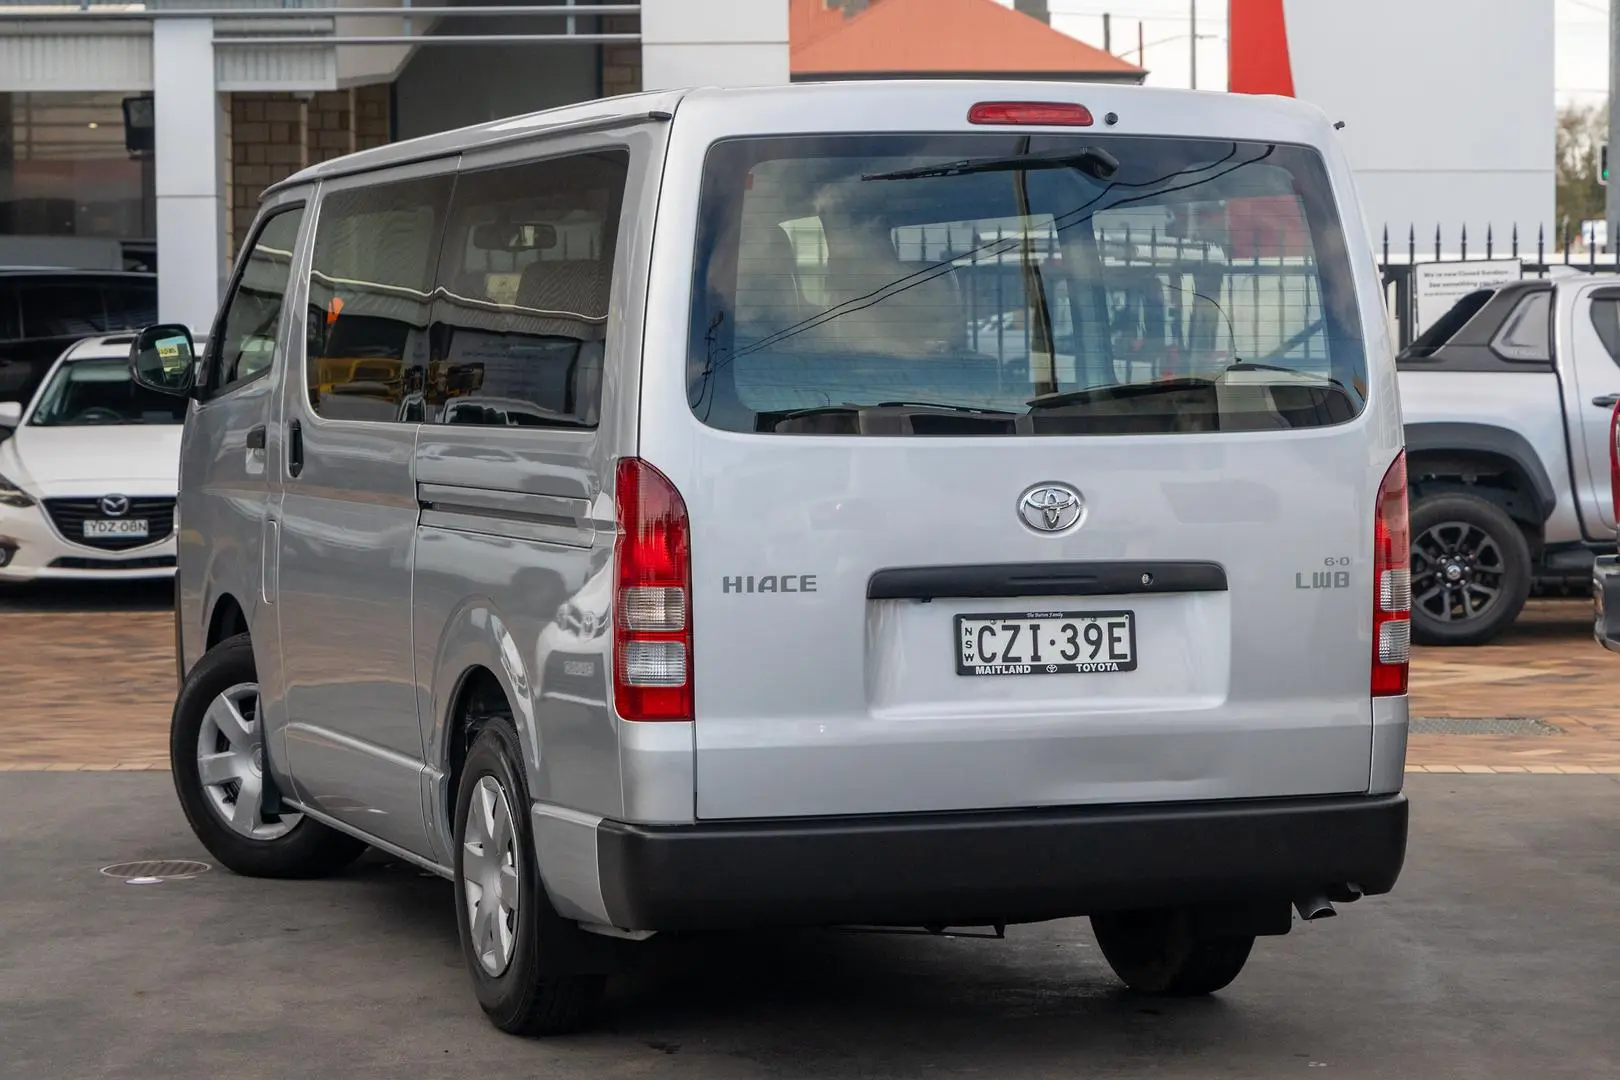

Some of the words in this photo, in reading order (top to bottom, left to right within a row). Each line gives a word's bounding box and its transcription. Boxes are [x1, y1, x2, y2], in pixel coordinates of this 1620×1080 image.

[723, 575, 817, 593] HIACE
[1295, 571, 1350, 589] LWB
[975, 665, 1031, 675] MAITLAND
[1076, 662, 1119, 673] TOYOTA
